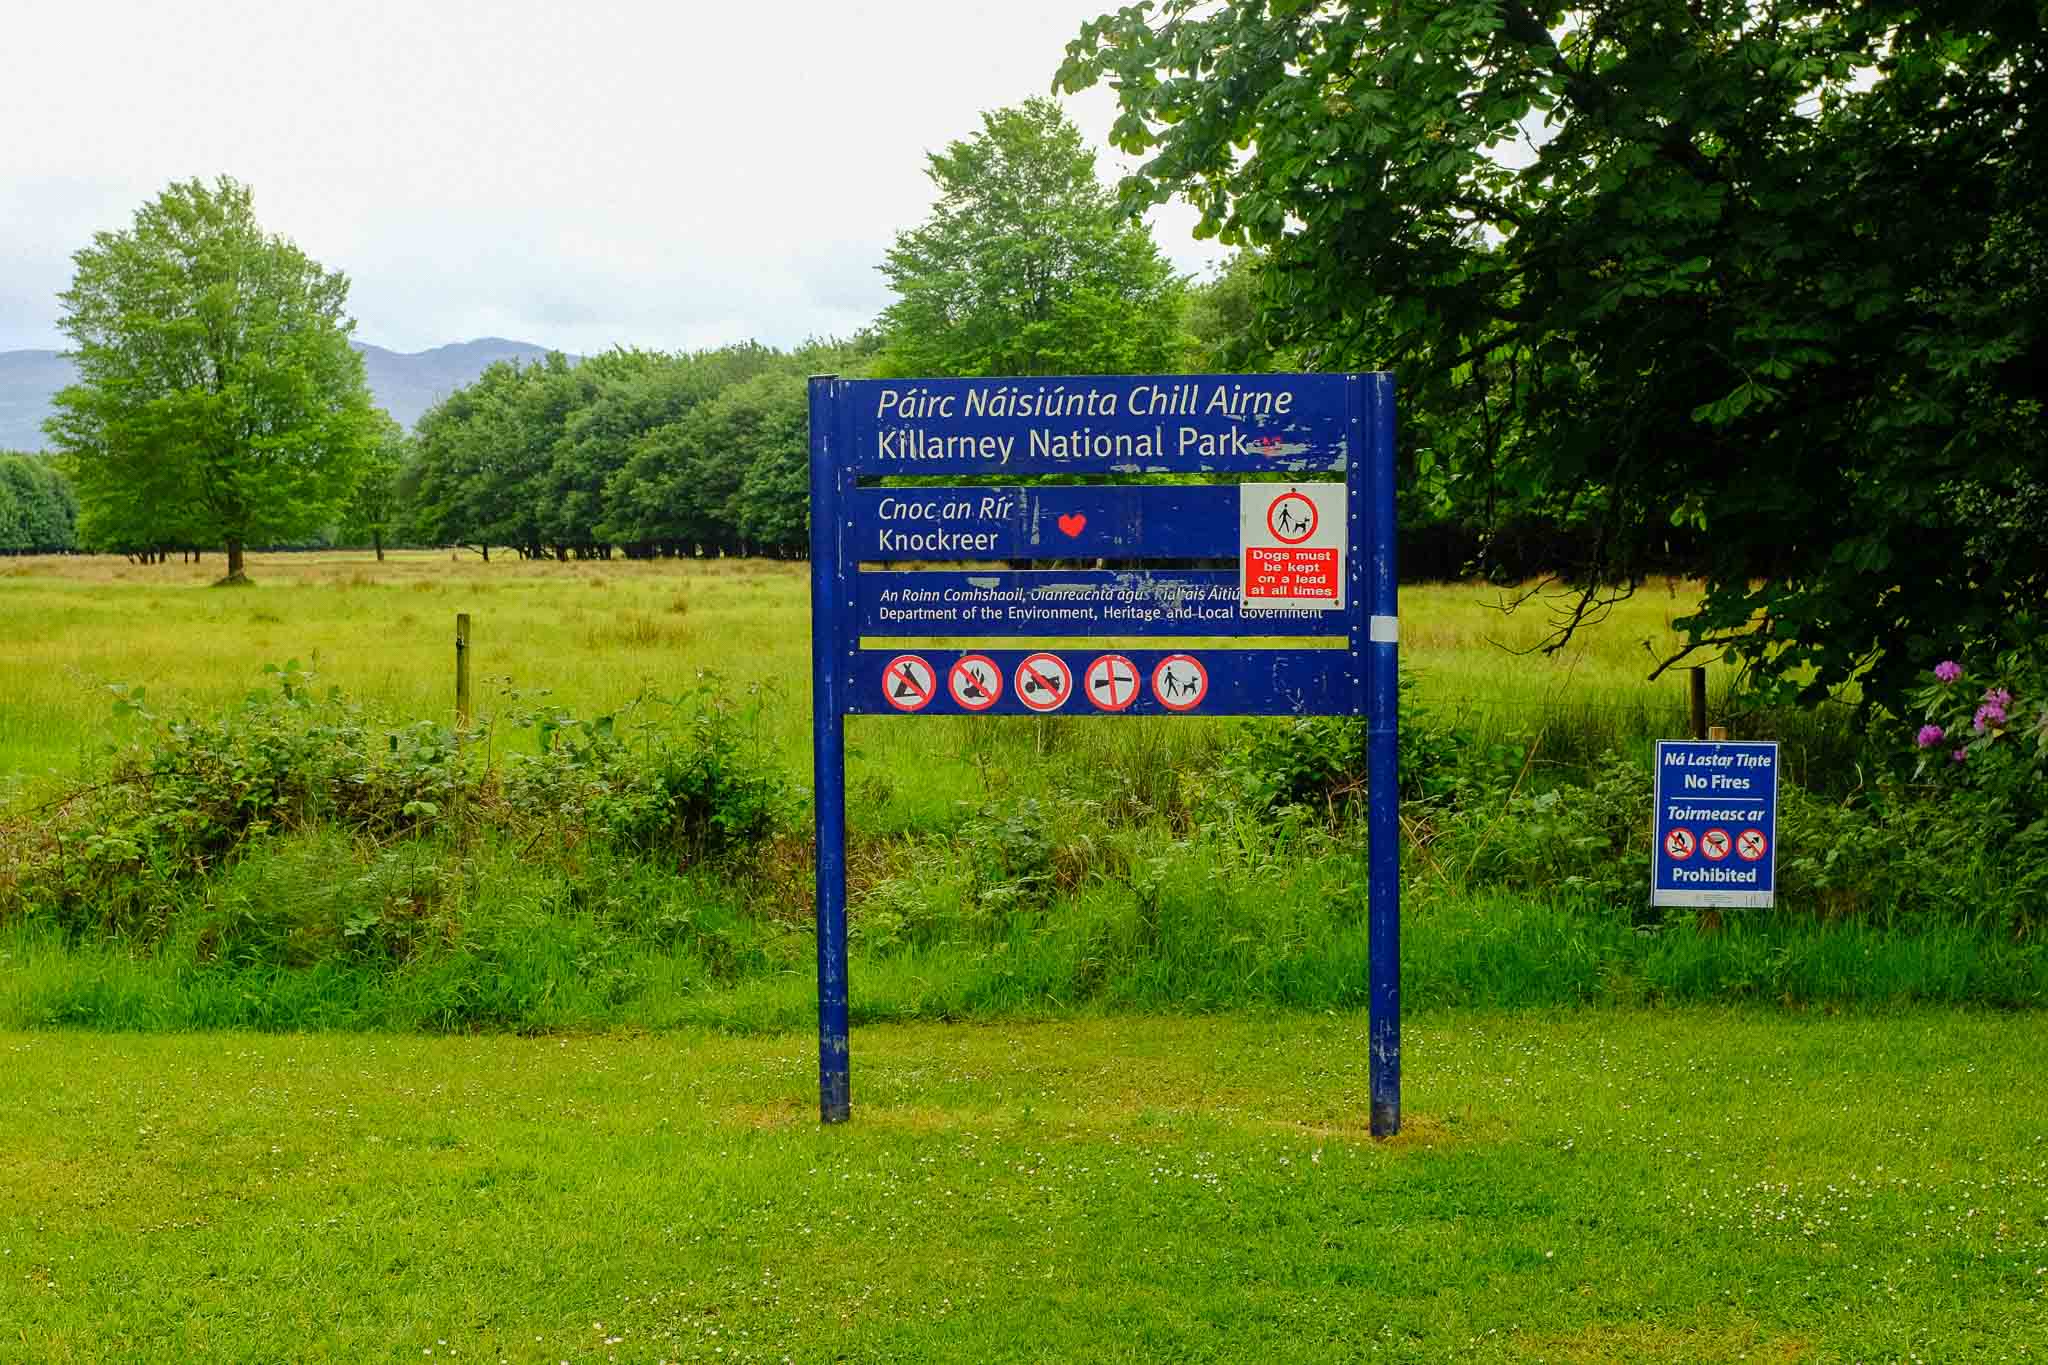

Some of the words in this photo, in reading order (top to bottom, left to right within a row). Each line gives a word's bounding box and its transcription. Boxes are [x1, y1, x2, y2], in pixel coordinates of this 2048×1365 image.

[877, 388, 956, 418] Páirc
[965, 386, 1118, 417] Náisiúnta
[1128, 384, 1199, 416] Chill
[1205, 384, 1293, 415] Airne
[878, 429, 1015, 464] Killarney
[1030, 426, 1164, 457] National
[1179, 426, 1249, 456] Park
[879, 498, 936, 520] Cnoc
[942, 504, 971, 520] an
[979, 496, 1014, 520] Rír
[879, 528, 999, 552] Knockreer
[1253, 550, 1290, 561] Dogs
[1296, 551, 1331, 560] must
[1264, 563, 1282, 572] be
[1288, 563, 1320, 573] kept
[1258, 575, 1275, 583] on
[1281, 575, 1290, 583] a
[1296, 574, 1326, 584] lead
[880, 589, 898, 602] An
[902, 588, 940, 602] Roinn
[944, 588, 1026, 604] Comhshaoil,
[1208, 585, 1241, 601] Áitiú
[1251, 586, 1265, 595] at
[1272, 586, 1288, 595] all
[1294, 586, 1332, 596] times
[880, 607, 958, 622] Department
[963, 606, 977, 620] of
[981, 606, 1002, 620] the
[1008, 606, 1098, 621] Environment,
[1104, 605, 1161, 621] Heritage
[1166, 605, 1192, 619] and
[1199, 605, 1233, 619] Local
[1240, 609, 1323, 619] Government
[1664, 753, 1685, 766] Ná
[1688, 753, 1733, 767] Lastar
[1736, 754, 1772, 767] Tinte
[1684, 775, 1708, 789] No
[1711, 775, 1750, 789] Fires
[1668, 806, 1745, 821] Toirmeasc
[1747, 810, 1765, 821] ar
[1672, 868, 1756, 883] Prohibited
